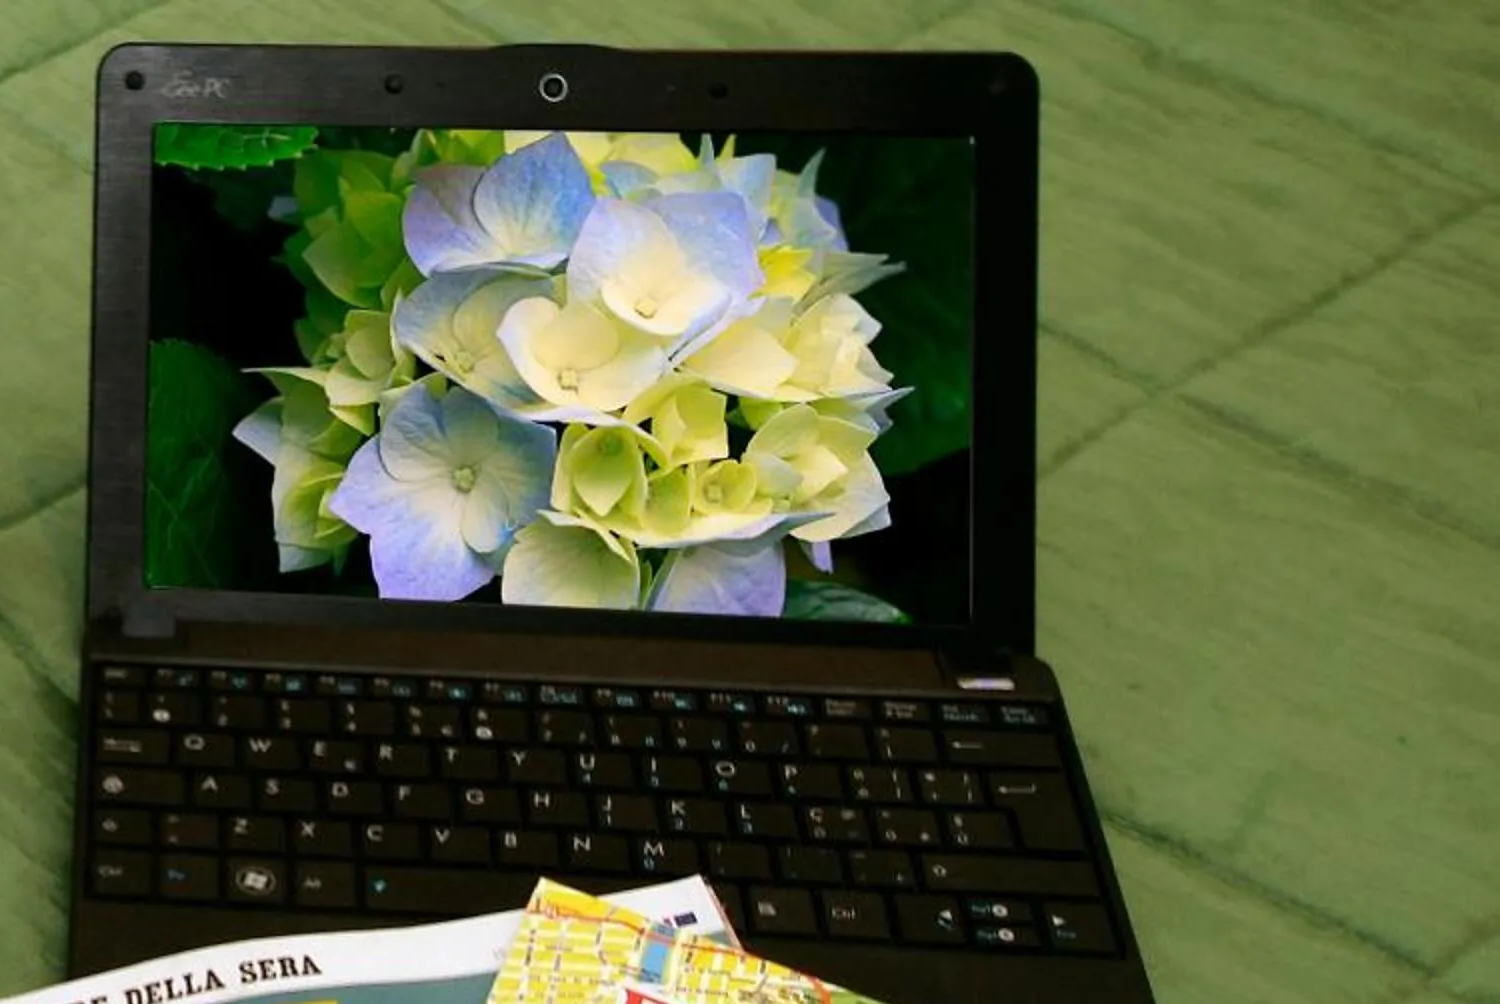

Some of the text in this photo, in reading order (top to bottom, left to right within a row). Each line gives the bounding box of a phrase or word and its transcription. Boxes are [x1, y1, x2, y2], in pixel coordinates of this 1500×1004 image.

[249, 738, 271, 752] W
[580, 754, 595, 770] U
[202, 776, 218, 791] A
[534, 792, 550, 808] H
[573, 835, 591, 851] N
[643, 840, 665, 857] M
[240, 954, 323, 986] SERA
